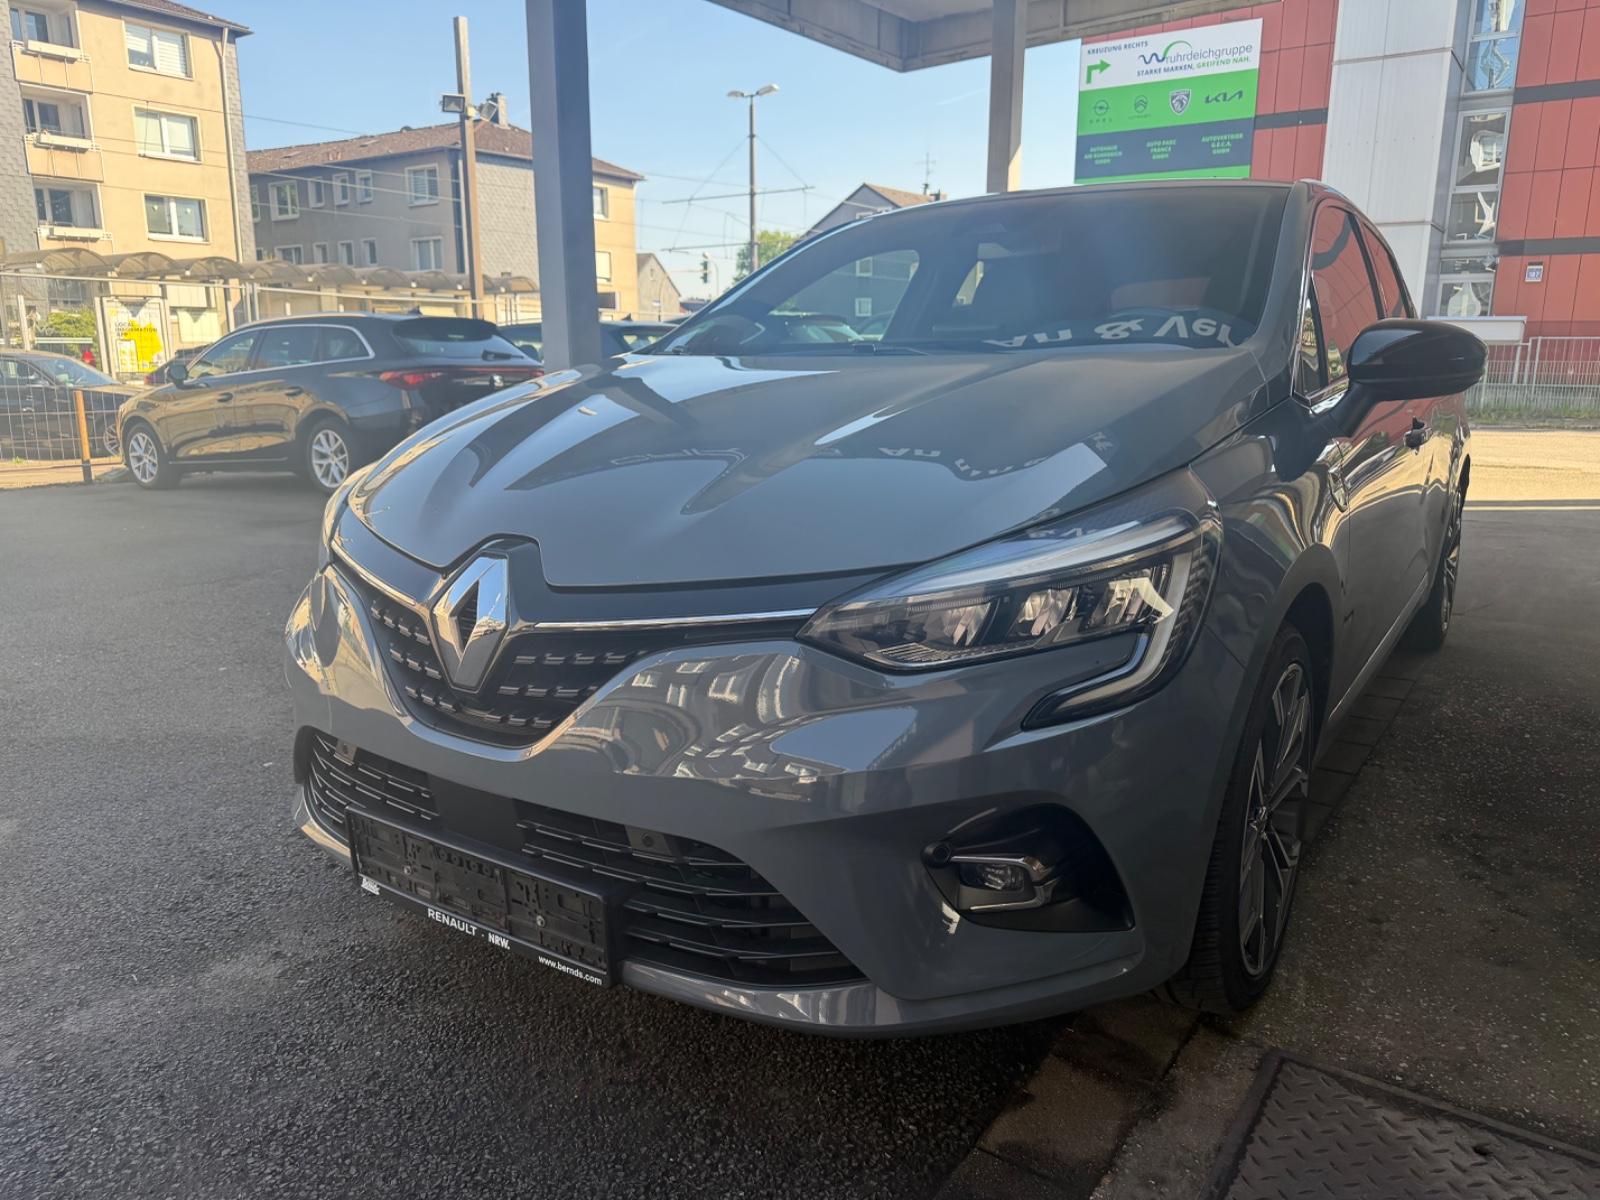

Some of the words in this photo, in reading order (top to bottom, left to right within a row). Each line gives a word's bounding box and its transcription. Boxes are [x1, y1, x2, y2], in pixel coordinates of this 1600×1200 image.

[1087, 44, 1122, 55] KREUZUNG
[1124, 40, 1149, 51] RECHTS
[1165, 43, 1253, 64] ruhrdeichgruppe
[1137, 67, 1162, 77] STARKE
[1196, 58, 1231, 69] GREIFEND
[427, 907, 477, 936] RENAULT
[538, 954, 603, 986] www.bernds.com
